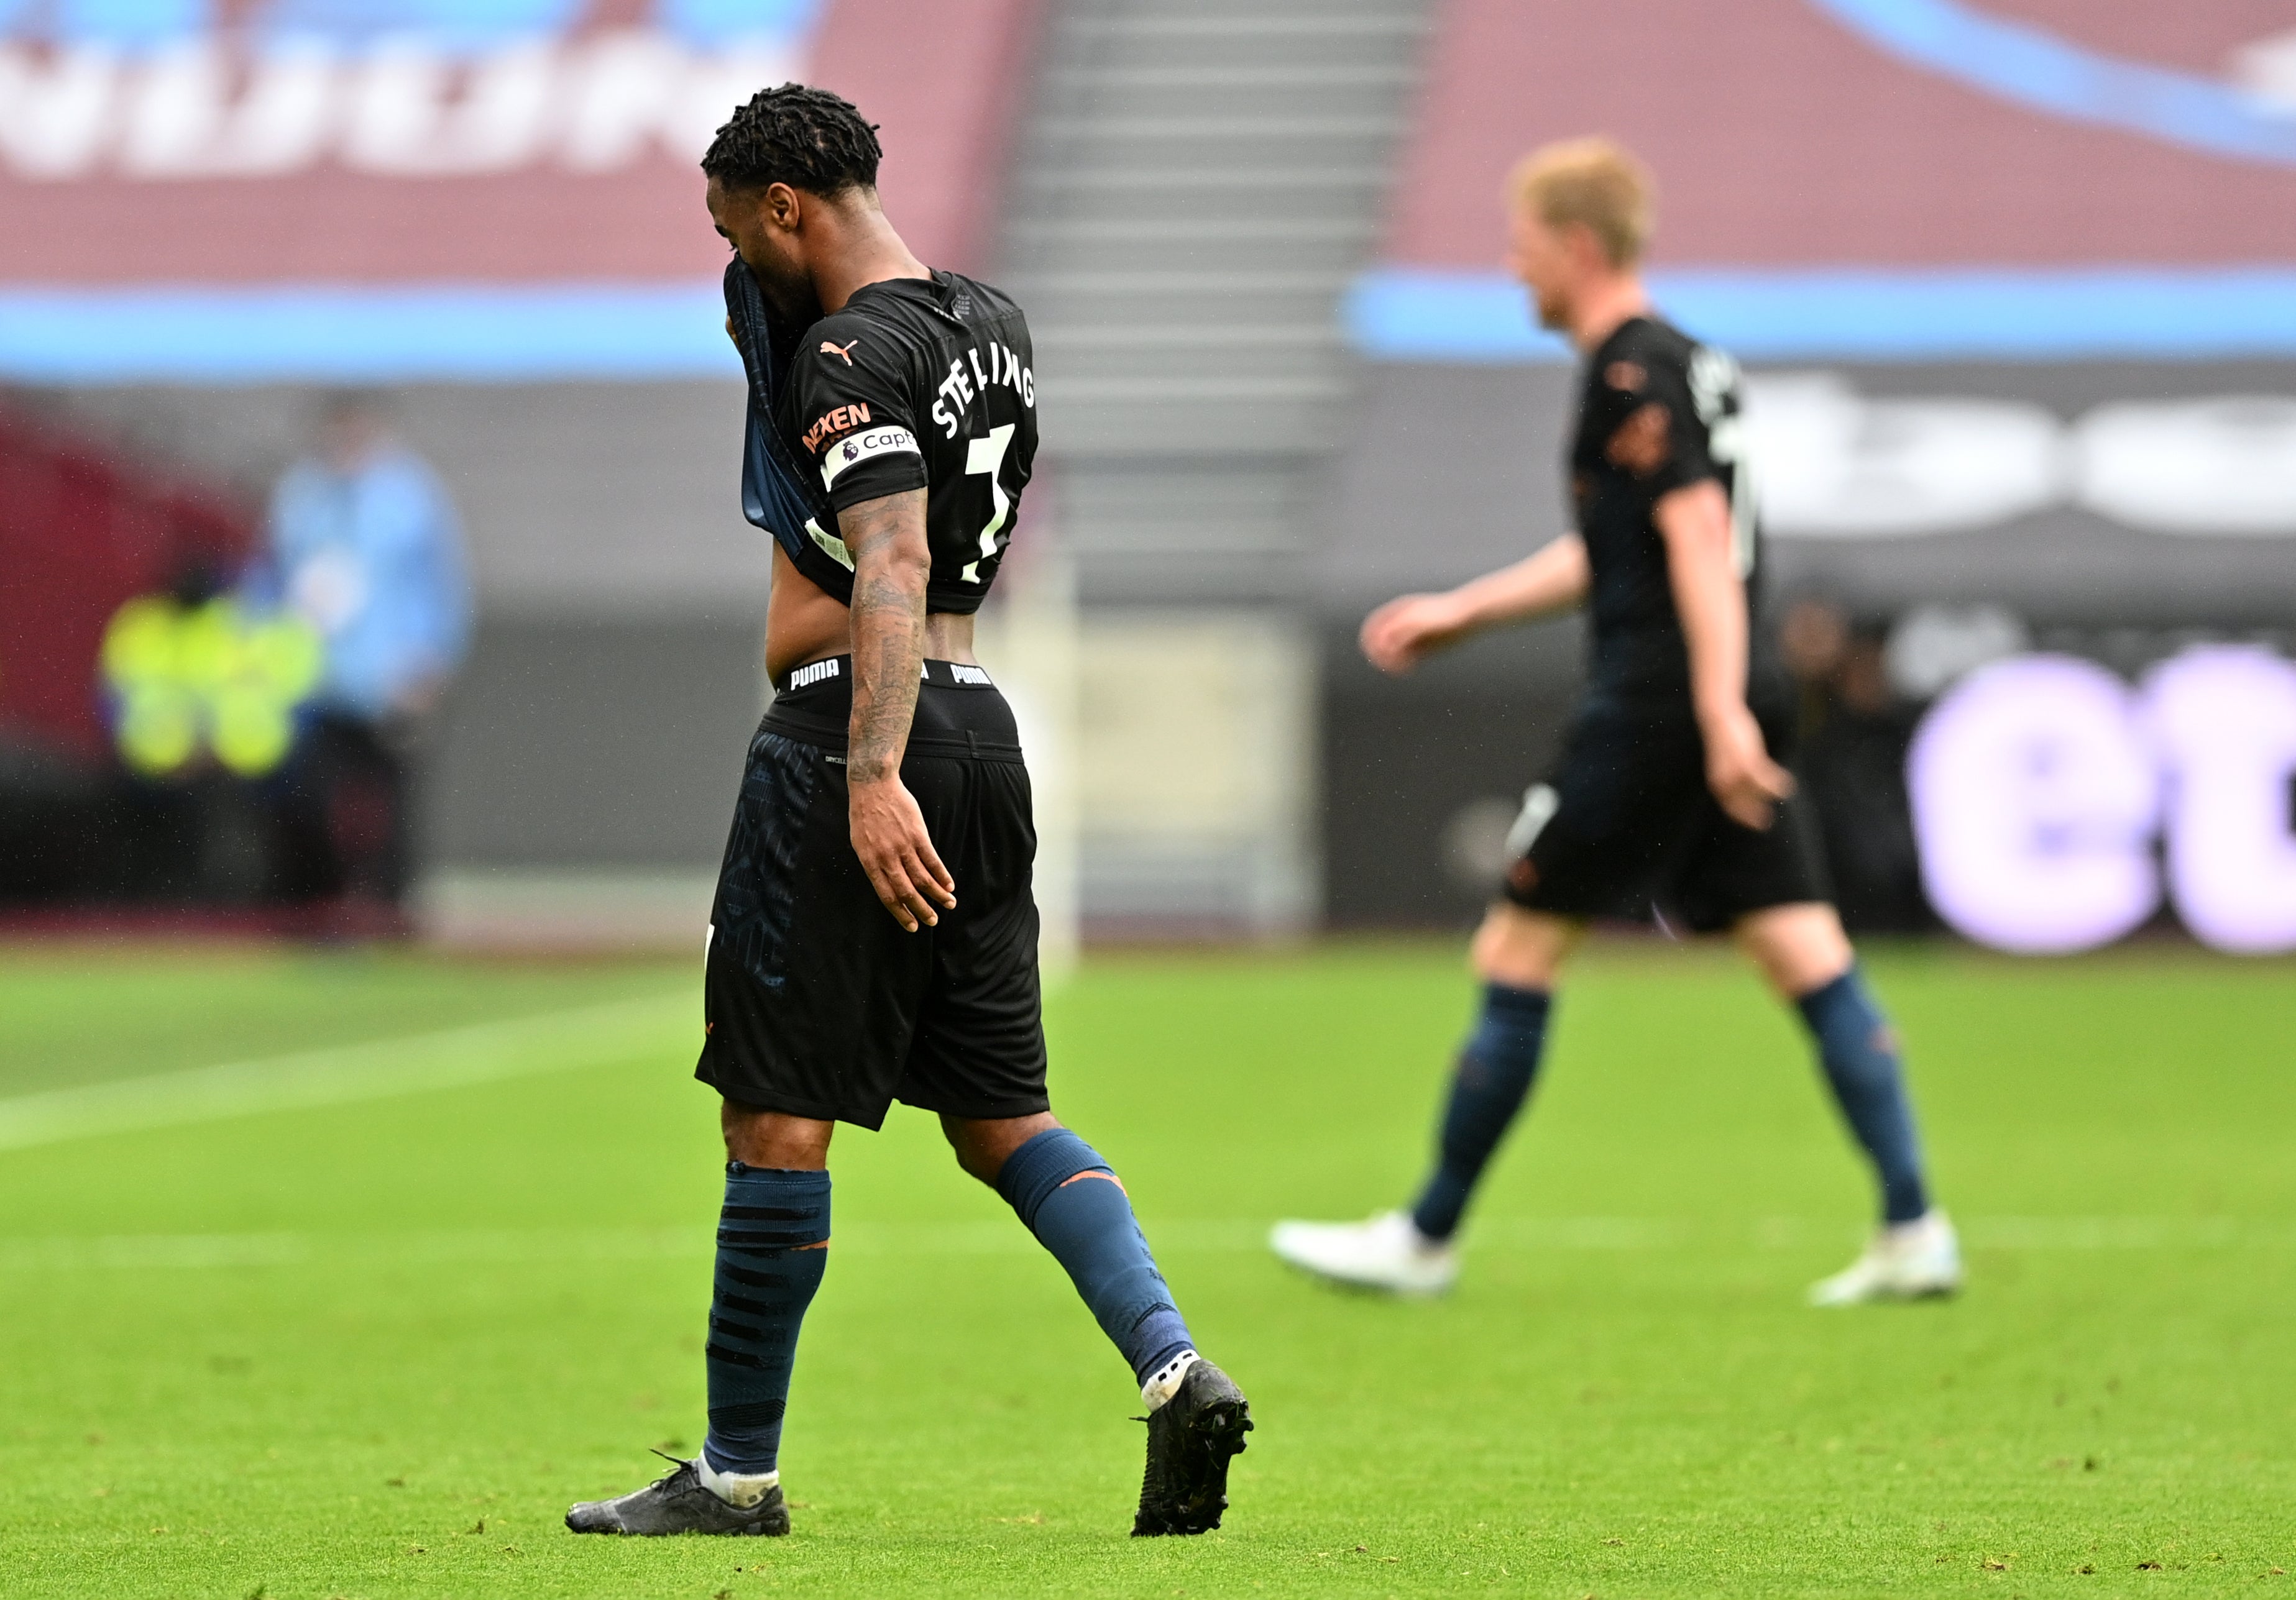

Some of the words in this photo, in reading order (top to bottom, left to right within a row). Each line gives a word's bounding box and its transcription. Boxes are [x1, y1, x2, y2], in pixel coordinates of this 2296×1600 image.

[932, 342, 1034, 439] STELING
[802, 402, 871, 454] NEXEN
[863, 431, 914, 449] Capt
[962, 423, 1015, 583] 7
[791, 659, 839, 690] PUMA
